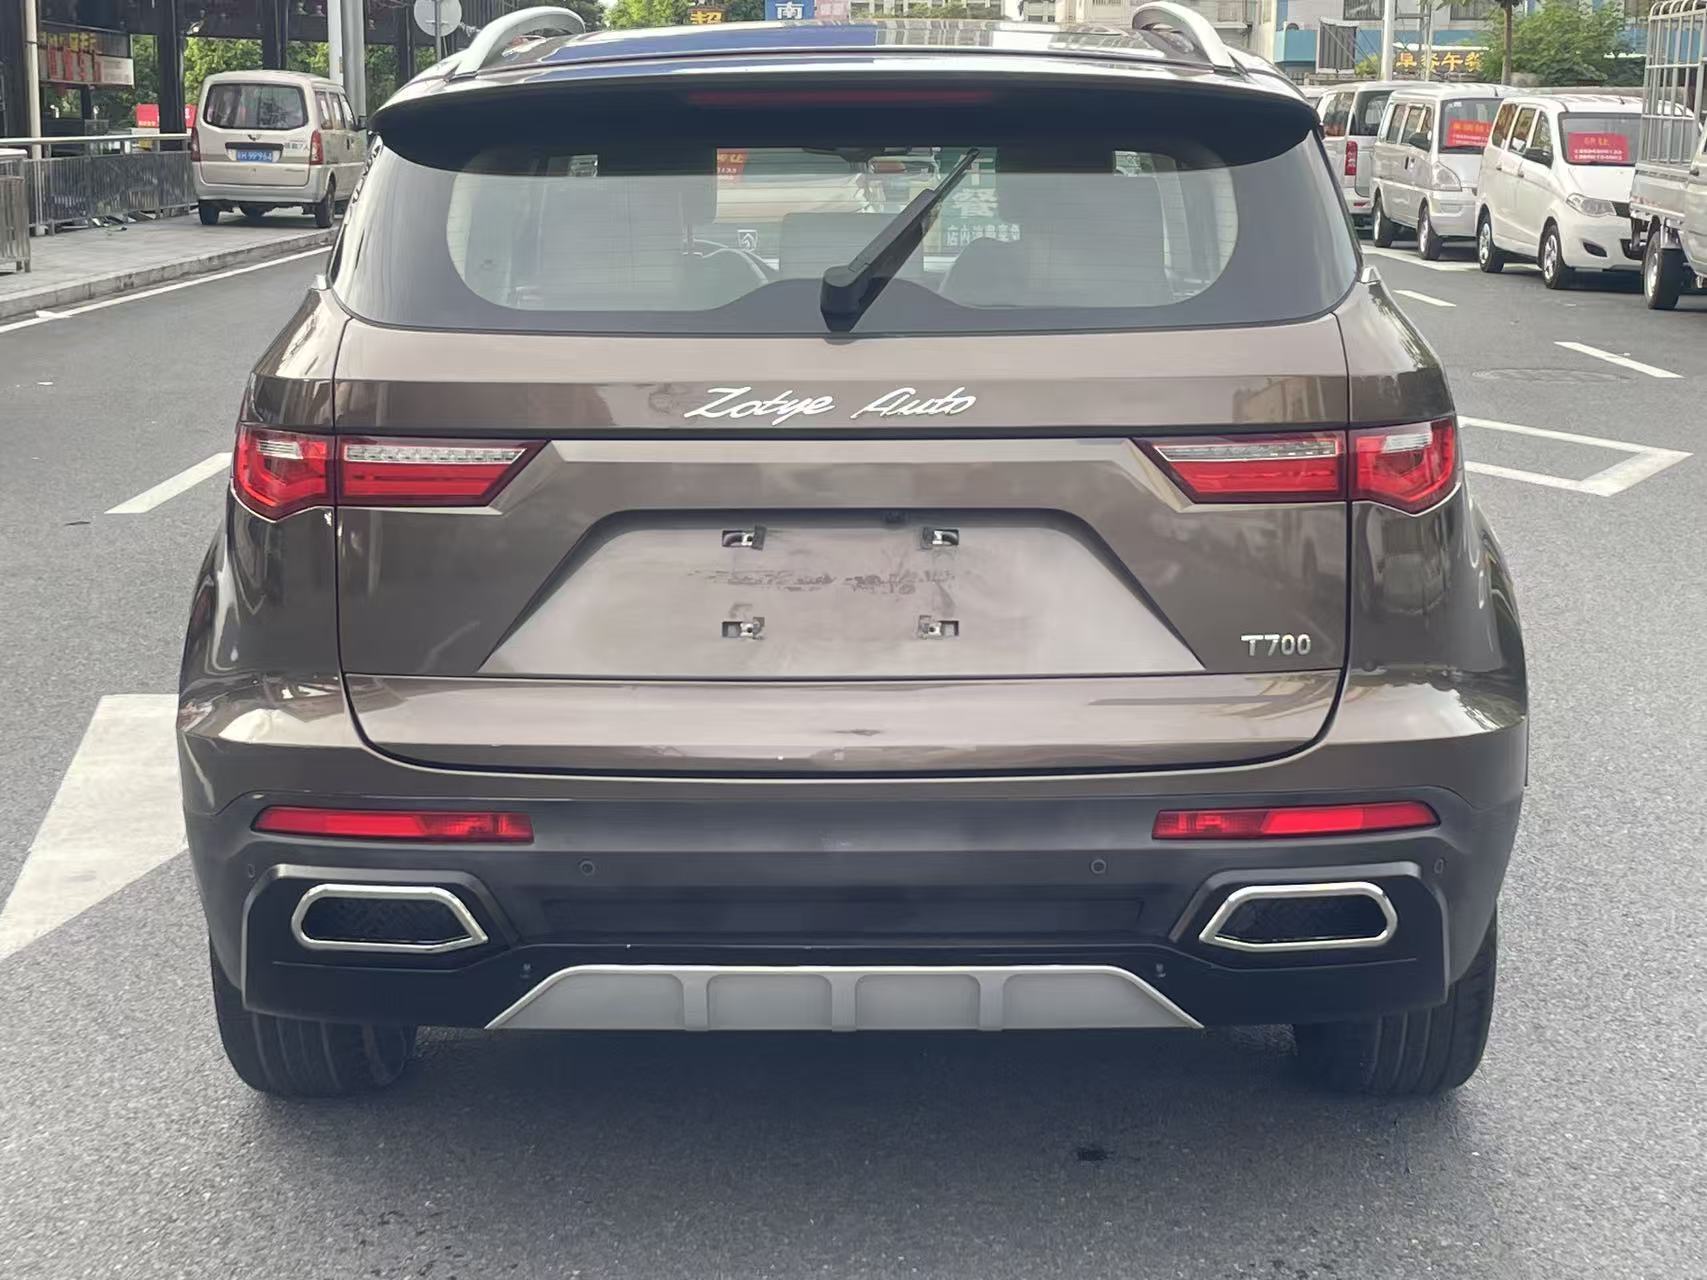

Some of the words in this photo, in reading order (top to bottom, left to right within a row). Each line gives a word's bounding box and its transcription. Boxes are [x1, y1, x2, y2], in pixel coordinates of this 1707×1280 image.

[683, 385, 836, 427] Zotye
[849, 386, 978, 420] Auto
[1240, 633, 1312, 656] T700
